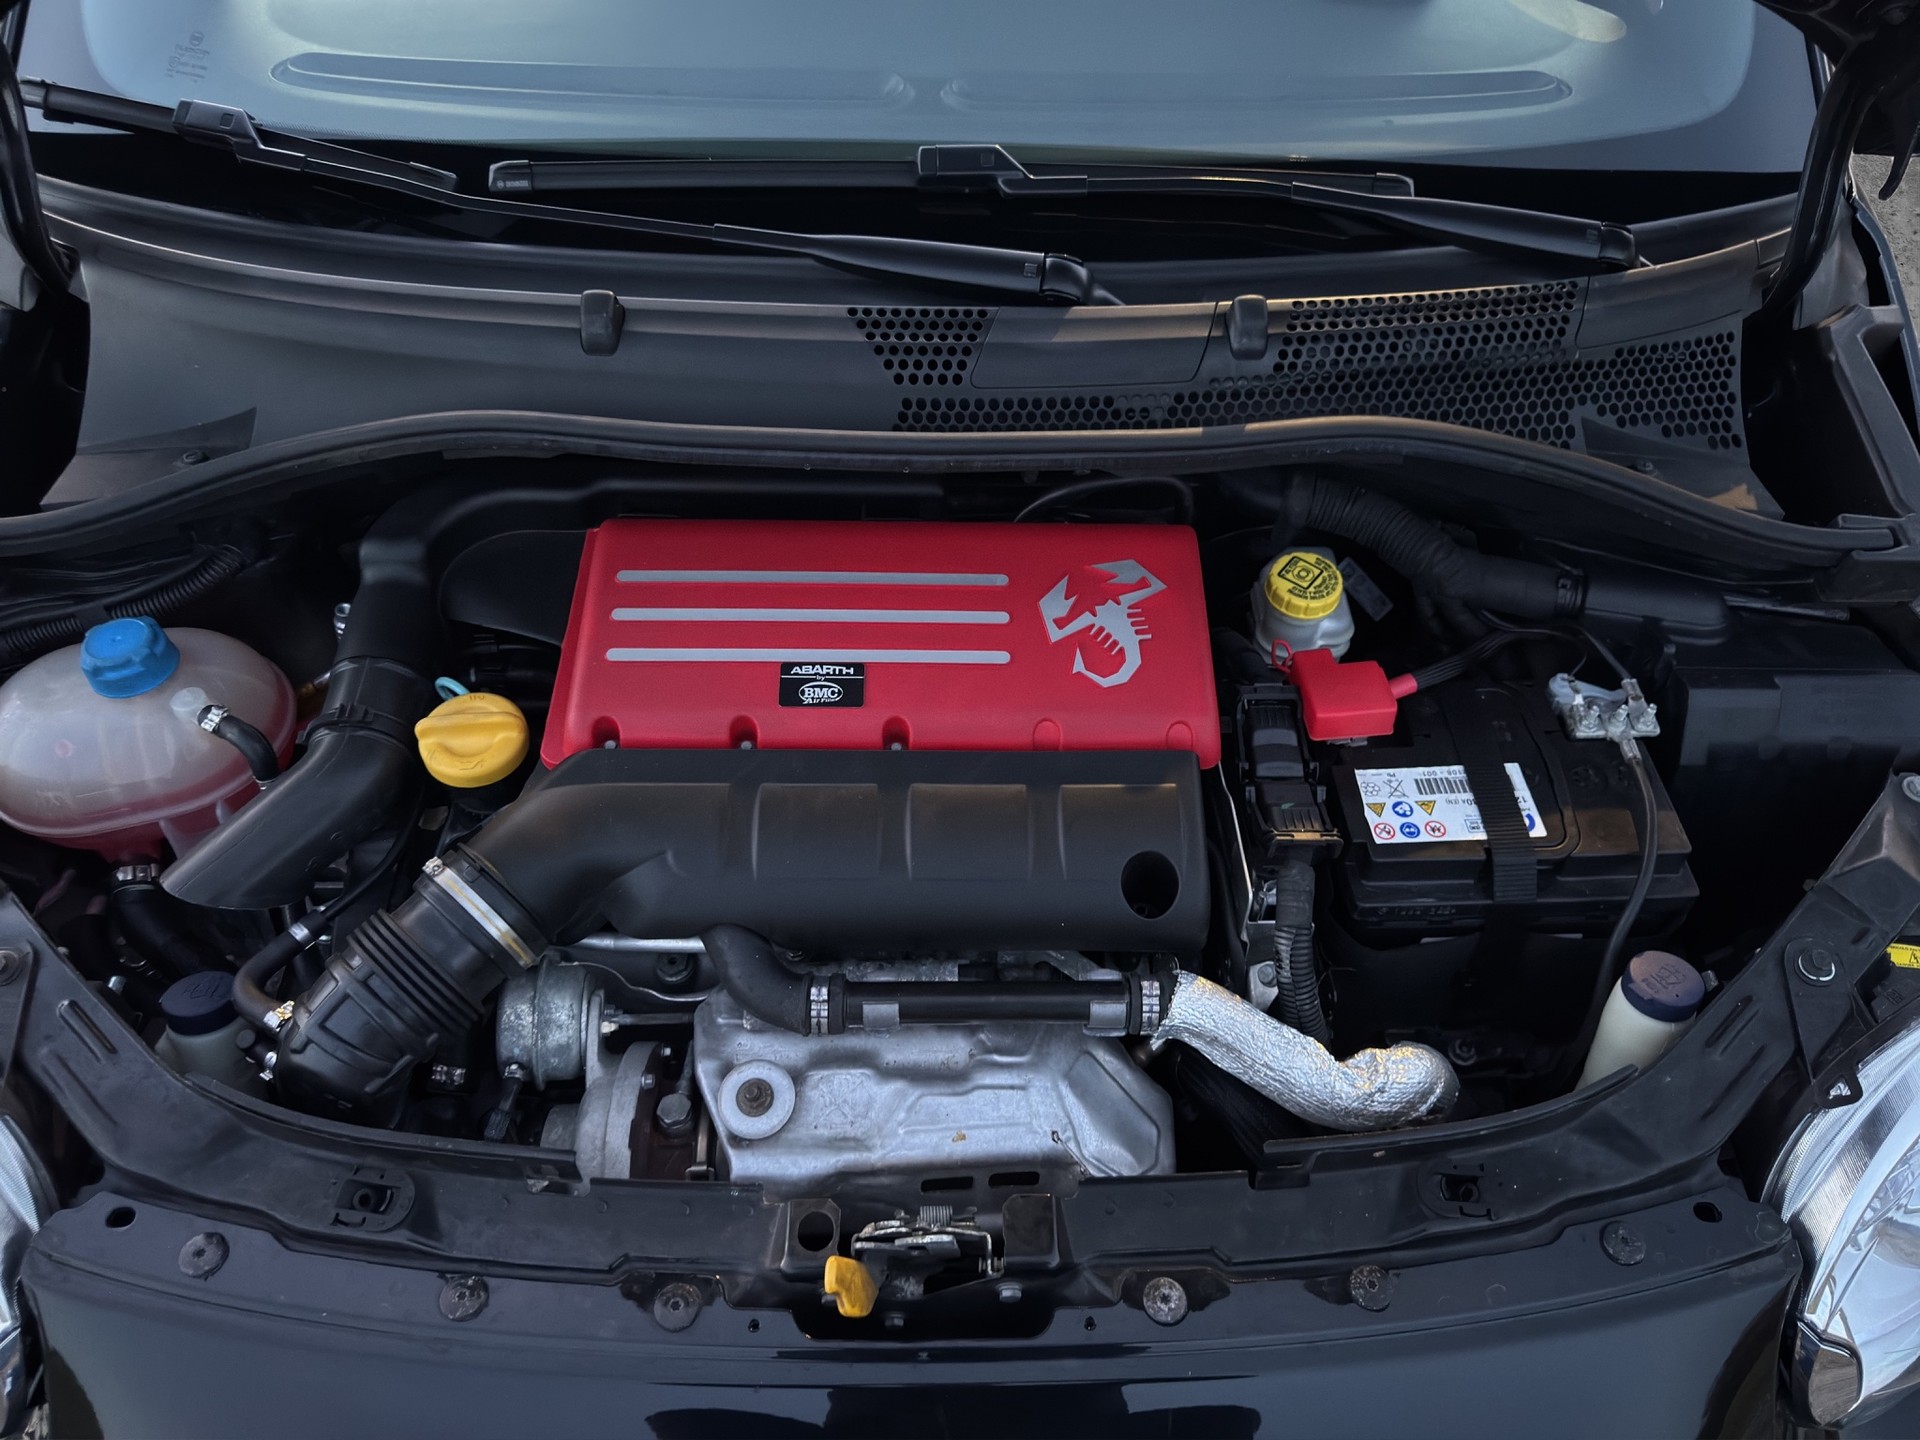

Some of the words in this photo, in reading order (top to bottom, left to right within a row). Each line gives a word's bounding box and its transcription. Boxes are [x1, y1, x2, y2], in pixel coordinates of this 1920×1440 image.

[790, 665, 854, 675] ABARTH
[803, 687, 839, 698] BMC
[802, 697, 821, 705] Air
